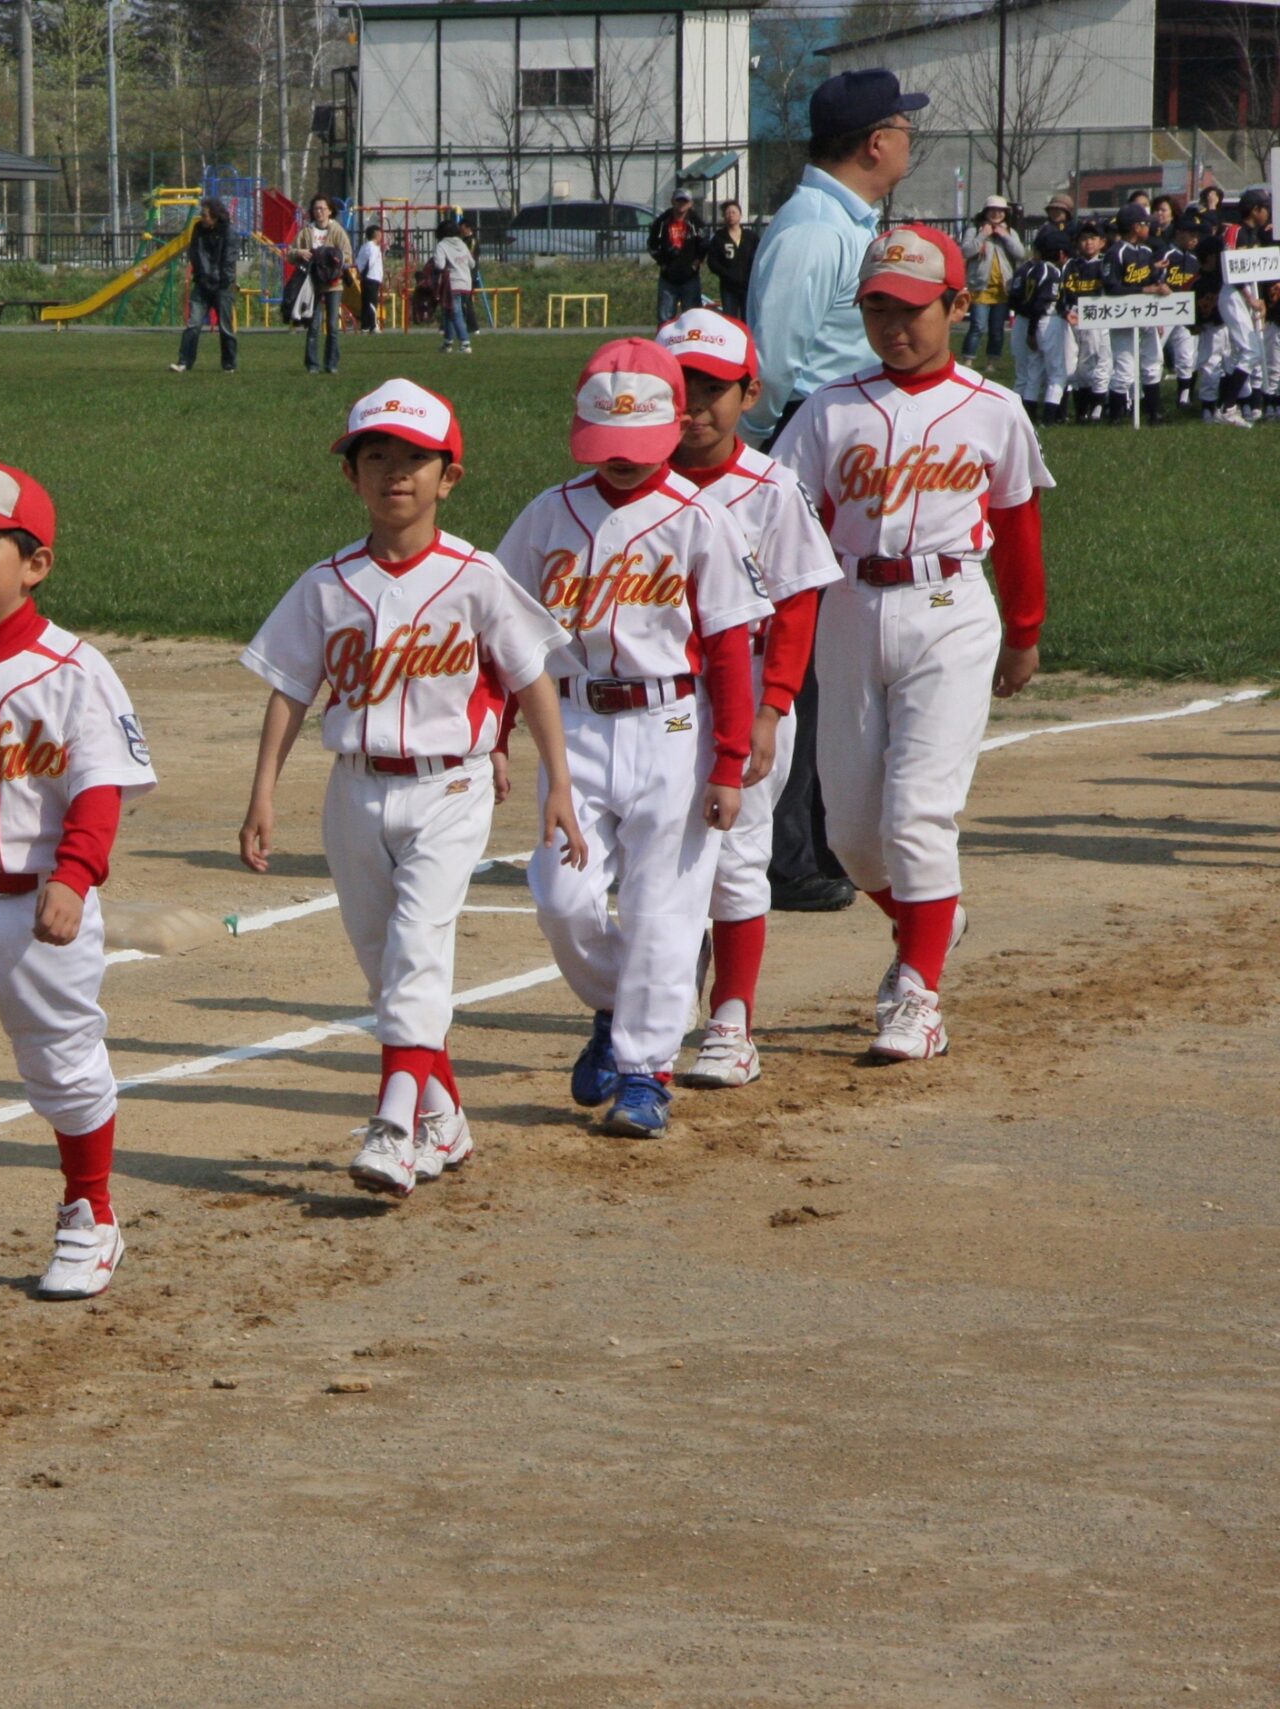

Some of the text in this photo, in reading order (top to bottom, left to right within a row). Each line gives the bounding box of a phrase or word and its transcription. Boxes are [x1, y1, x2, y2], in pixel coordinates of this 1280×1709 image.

[724, 243, 735, 259] 5
[1082, 300, 1190, 321] 菊水ジャガーズ
[839, 443, 984, 519] Buffalos
